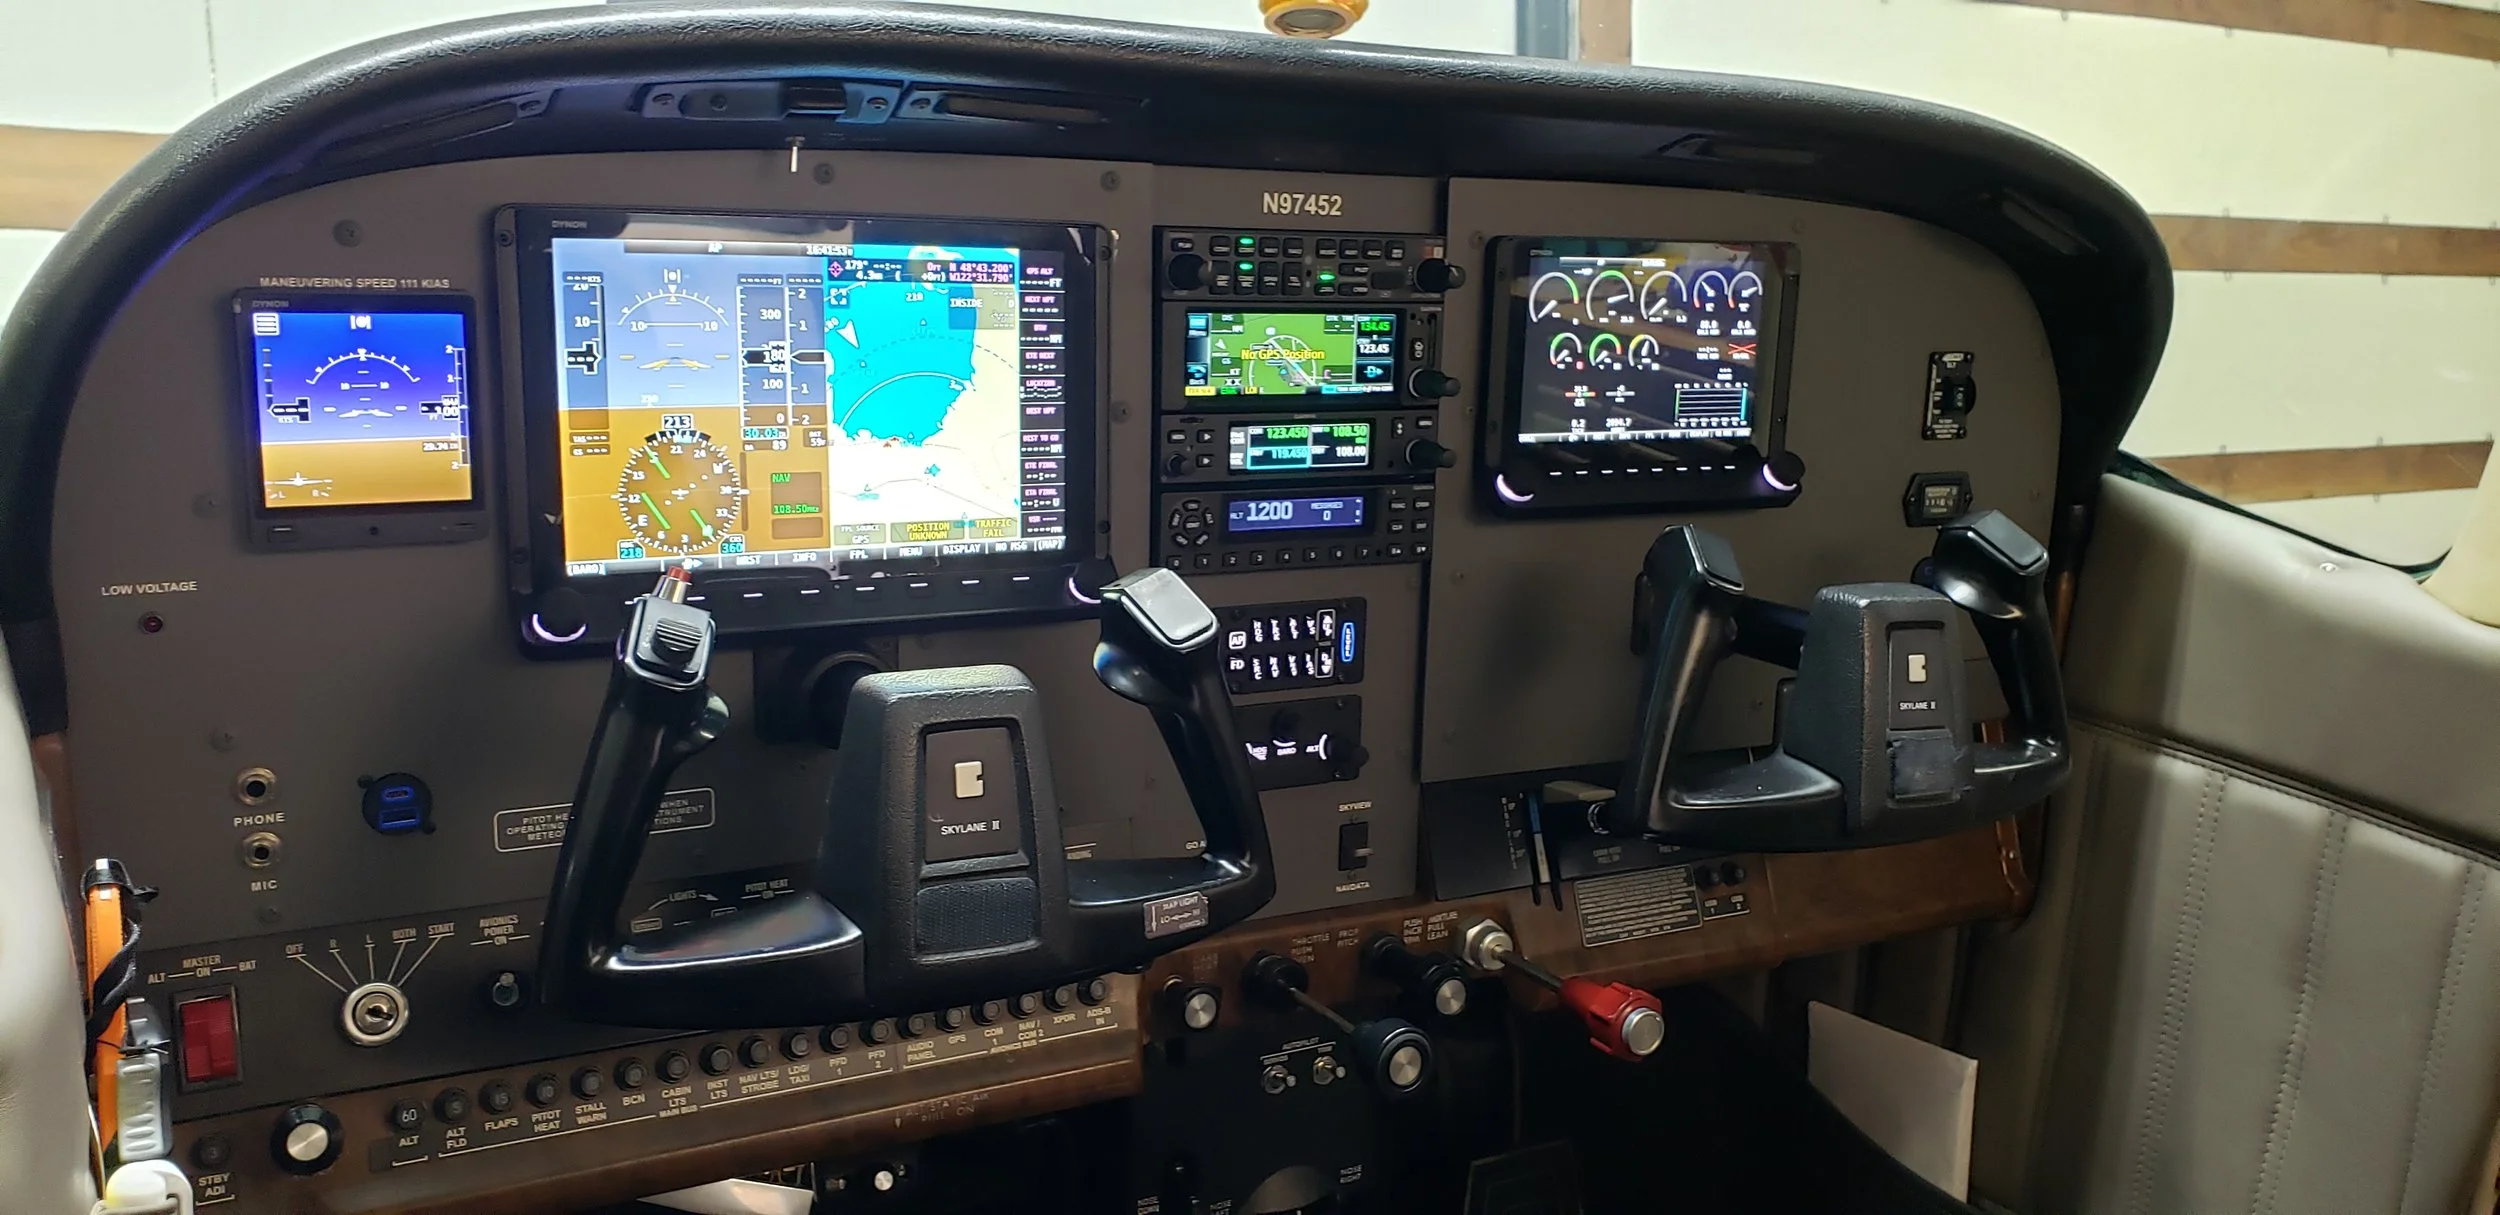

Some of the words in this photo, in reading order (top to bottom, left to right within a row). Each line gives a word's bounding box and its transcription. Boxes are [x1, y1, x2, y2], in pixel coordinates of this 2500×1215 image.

[1262, 192, 1342, 216] N97452
[260, 277, 353, 288] MANEUVERING
[356, 277, 396, 288] SPEED
[400, 278, 418, 288] 111
[421, 279, 450, 289] KIAS
[797, 289, 806, 299] 2
[950, 298, 983, 308] INSIDE
[759, 309, 782, 320] 300
[574, 316, 591, 328] 10
[703, 321, 718, 333] 10
[799, 320, 807, 331] 1
[1360, 321, 1390, 332] 134.45
[1241, 350, 1256, 360] No
[1258, 349, 1280, 360] GPS
[1283, 348, 1325, 360] Position
[1359, 343, 1390, 354] 123.45
[762, 379, 784, 390] 100
[664, 417, 691, 429] 213
[776, 413, 785, 424] 0
[801, 414, 810, 425] 2
[743, 428, 779, 438] 30.03
[1267, 427, 1308, 439] 123.450
[772, 440, 787, 451] 89
[713, 462, 724, 475] W
[772, 474, 790, 483] NAV
[1247, 501, 1293, 521] 1200
[1322, 510, 1332, 521] 0
[638, 515, 648, 527] E
[975, 518, 1012, 529] TRAFFIC
[906, 522, 950, 533] POSITION
[983, 528, 1004, 537] FAIL
[852, 534, 870, 544] GPS
[909, 531, 948, 541] UNKNOWN
[721, 543, 744, 554] 360
[900, 546, 923, 556] MENU
[943, 543, 981, 554] DISPLAY
[995, 541, 1008, 551] NO
[1010, 541, 1028, 551] MSG
[619, 549, 643, 559] 218
[849, 549, 868, 559] FPL
[101, 583, 133, 597] LOW
[135, 581, 198, 595] VOLTAGE
[1231, 636, 1244, 646] AP
[1230, 660, 1245, 670] FD
[1899, 701, 1929, 711] SKYLANE
[232, 812, 286, 828] PHONE
[522, 814, 553, 825] PITOT
[506, 822, 565, 836] OPERATING
[941, 821, 988, 836] SKYLANE
[991, 820, 1000, 831] II
[250, 879, 278, 892] MIC
[745, 881, 767, 893] PITOT
[769, 878, 789, 889] HEAT
[669, 890, 697, 902] LIGHTS
[479, 914, 519, 929] AVIONICS
[1160, 914, 1170, 924] LO
[391, 927, 417, 940] BOTH
[427, 922, 455, 935] START
[483, 925, 515, 937] POWER
[1292, 932, 1331, 945] THROTTLE
[1427, 930, 1449, 940] LEAN
[285, 943, 304, 955] OFF
[181, 954, 222, 969] MASTER
[147, 972, 166, 984] ALT
[195, 966, 212, 977] ON
[238, 959, 257, 972] BAT
[1086, 1006, 1112, 1018] ADS-B
[1052, 1013, 1076, 1024] XPDR
[1096, 1017, 1105, 1026] IN
[1018, 1021, 1036, 1031] NAV
[984, 1027, 1003, 1037] COM
[1018, 1030, 1037, 1040] COM
[1038, 1029, 1045, 1037] 2
[948, 1034, 967, 1045] GPS
[991, 1038, 998, 1046] 1
[1022, 1039, 1038, 1048] BUS
[906, 1040, 935, 1053] AUDIO
[868, 1049, 886, 1060] PFD
[907, 1050, 936, 1062] PANEL
[829, 1057, 848, 1068] PFD
[875, 1060, 882, 1069] 2
[787, 1064, 810, 1076] LDG/
[836, 1067, 842, 1076] 1
[738, 1073, 758, 1084] NAV
[759, 1069, 779, 1081] LTS/
[788, 1073, 811, 1085] TAXI
[707, 1079, 729, 1090] INST
[741, 1080, 780, 1094] STROBE
[661, 1085, 692, 1099] CABIN
[711, 1090, 728, 1100] LTS
[622, 1093, 646, 1106] BCN
[668, 1097, 688, 1108] LTS
[575, 1102, 607, 1115] STALL
[659, 1107, 679, 1118] MAIN
[680, 1104, 698, 1115] BUS
[401, 1108, 417, 1122] 60
[531, 1109, 562, 1123] PITOT
[576, 1112, 607, 1125] WARN
[484, 1117, 519, 1132] FLAPS
[533, 1120, 561, 1132] HEAT
[446, 1127, 466, 1139] ALT
[398, 1134, 419, 1147] ALT
[446, 1138, 467, 1149] FLD
[198, 1173, 230, 1187] STBY
[204, 1185, 226, 1197] ADI
